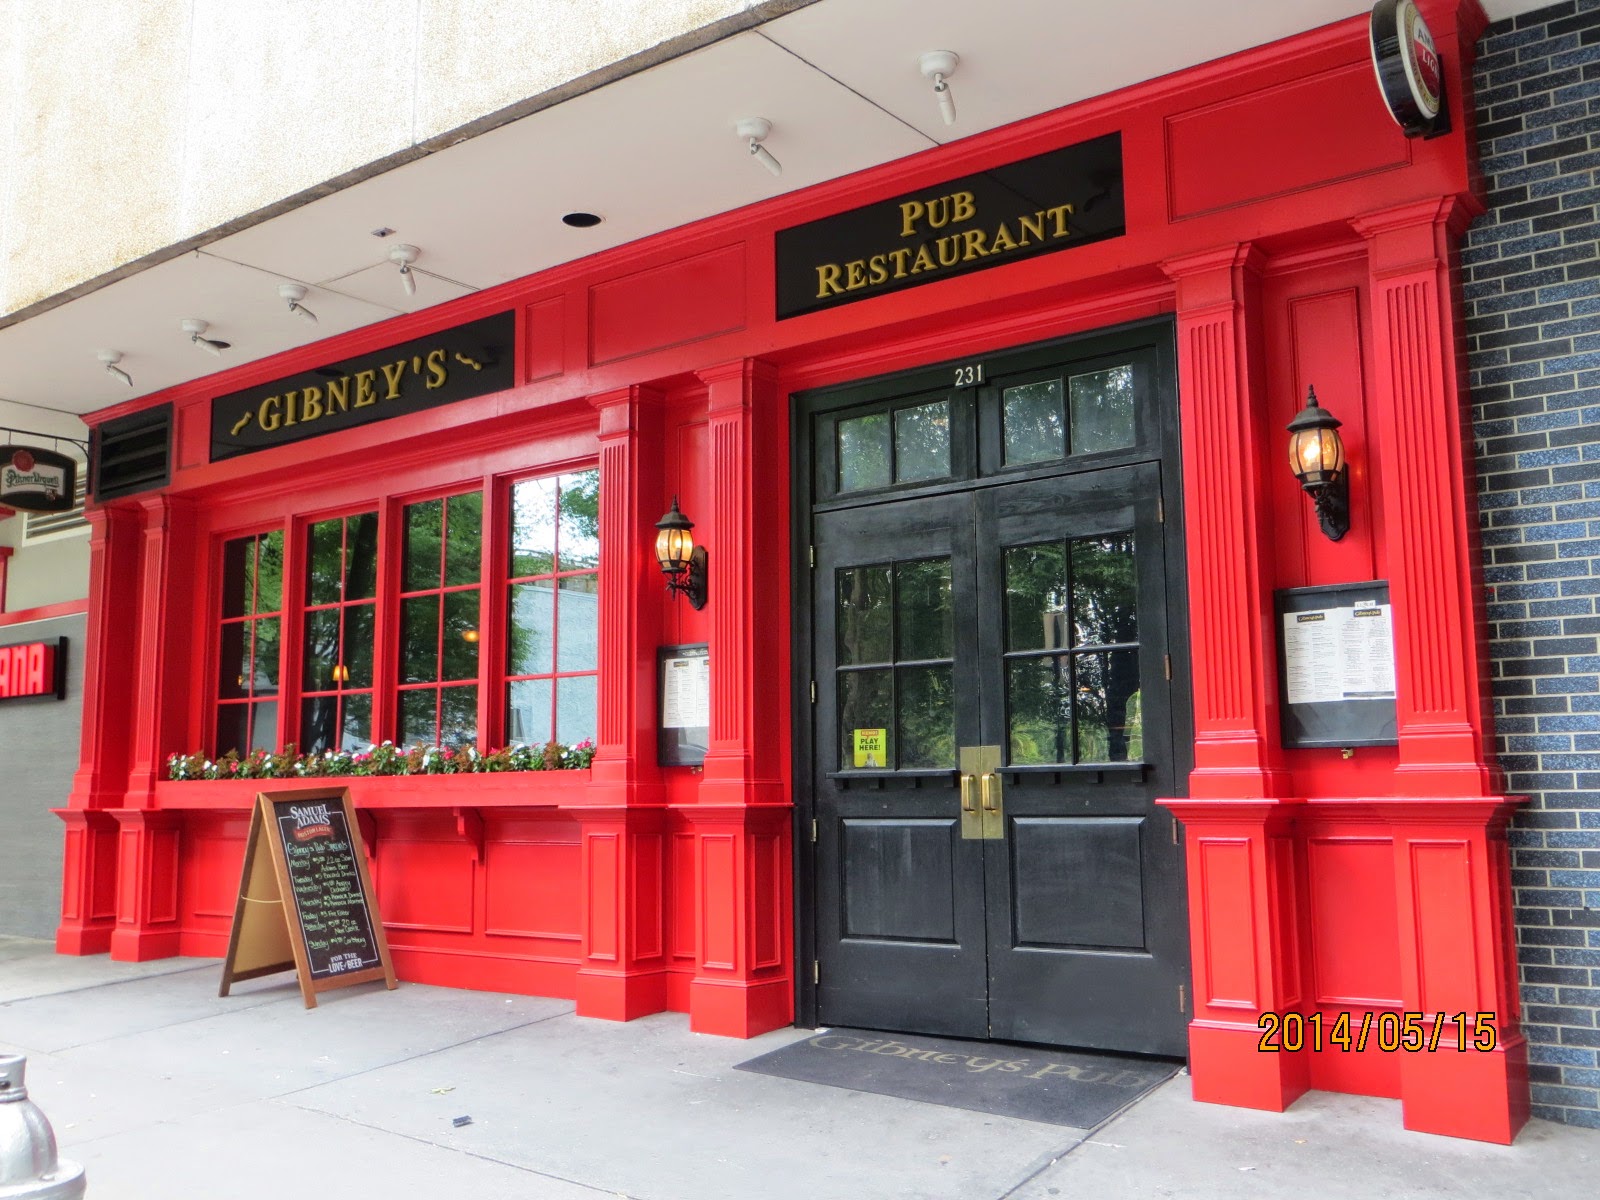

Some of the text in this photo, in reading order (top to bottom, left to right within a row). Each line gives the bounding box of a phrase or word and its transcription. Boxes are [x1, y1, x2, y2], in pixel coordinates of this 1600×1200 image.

[900, 191, 976, 237] PUB
[815, 203, 1074, 299] RESTAURANT
[955, 364, 982, 387] 231
[258, 349, 447, 431] GIBNEY'S
[290, 803, 331, 819] SAMUEL
[297, 814, 331, 829] ADAMS
[328, 960, 345, 973] LOVE
[347, 957, 363, 970] BEER
[343, 952, 358, 960] THE
